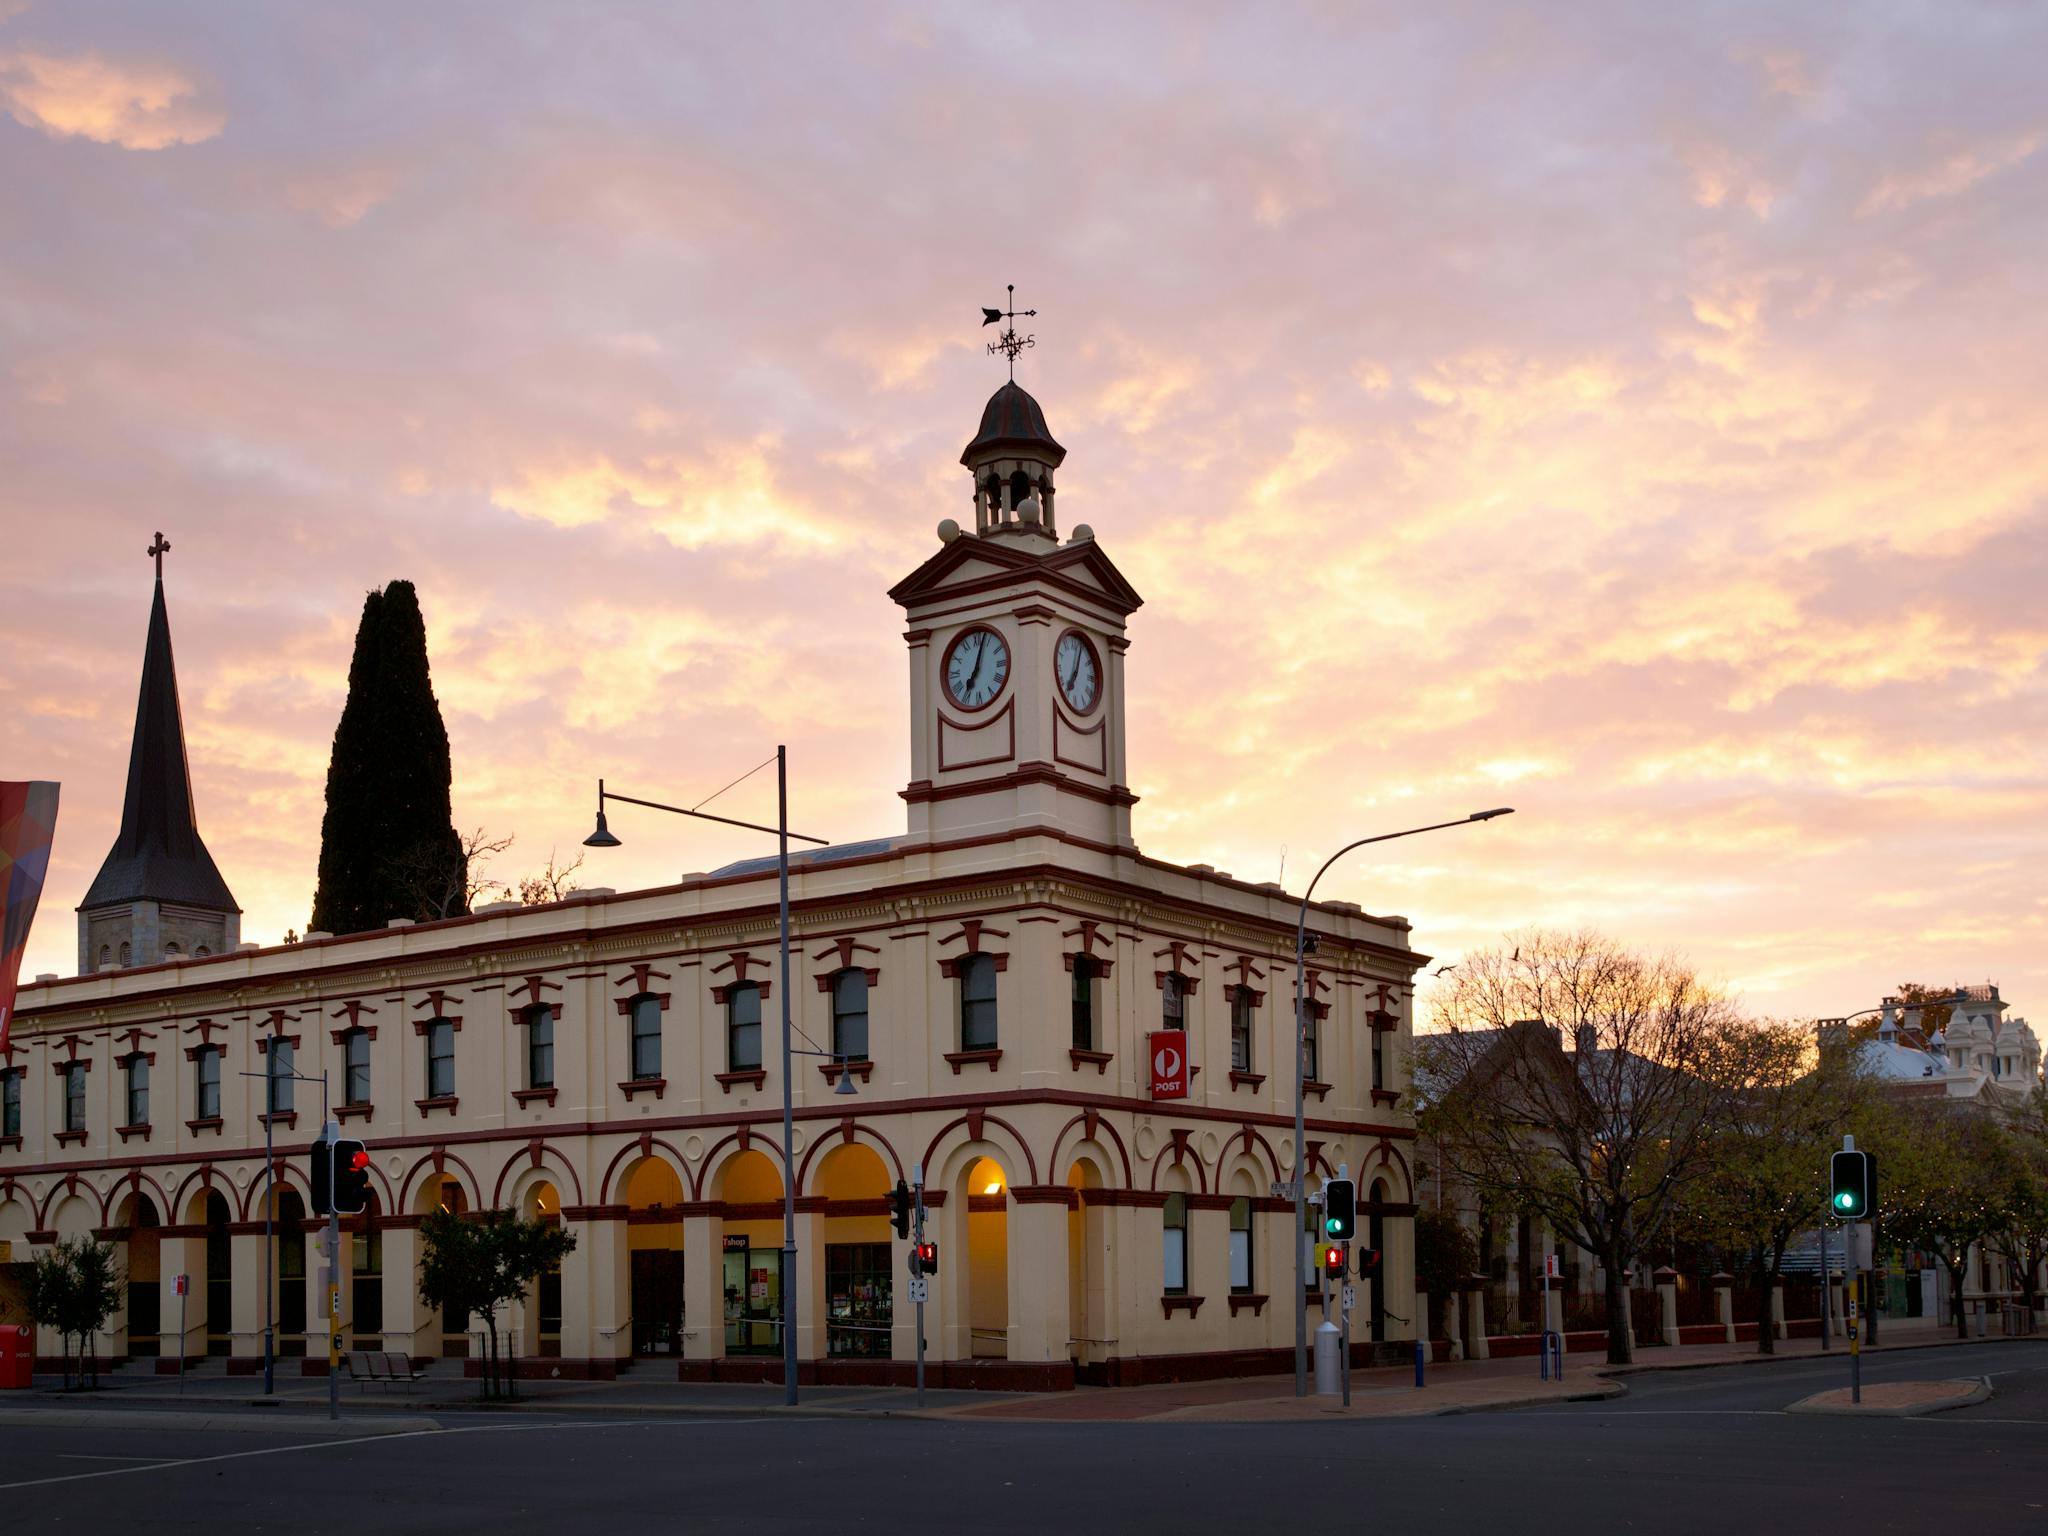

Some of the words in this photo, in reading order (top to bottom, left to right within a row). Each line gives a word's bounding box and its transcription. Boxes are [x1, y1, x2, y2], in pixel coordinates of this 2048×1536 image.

[1027, 334, 1036, 348] S
[987, 342, 995, 356] N
[952, 655, 962, 665] X
[1155, 1081, 1181, 1092] POST
